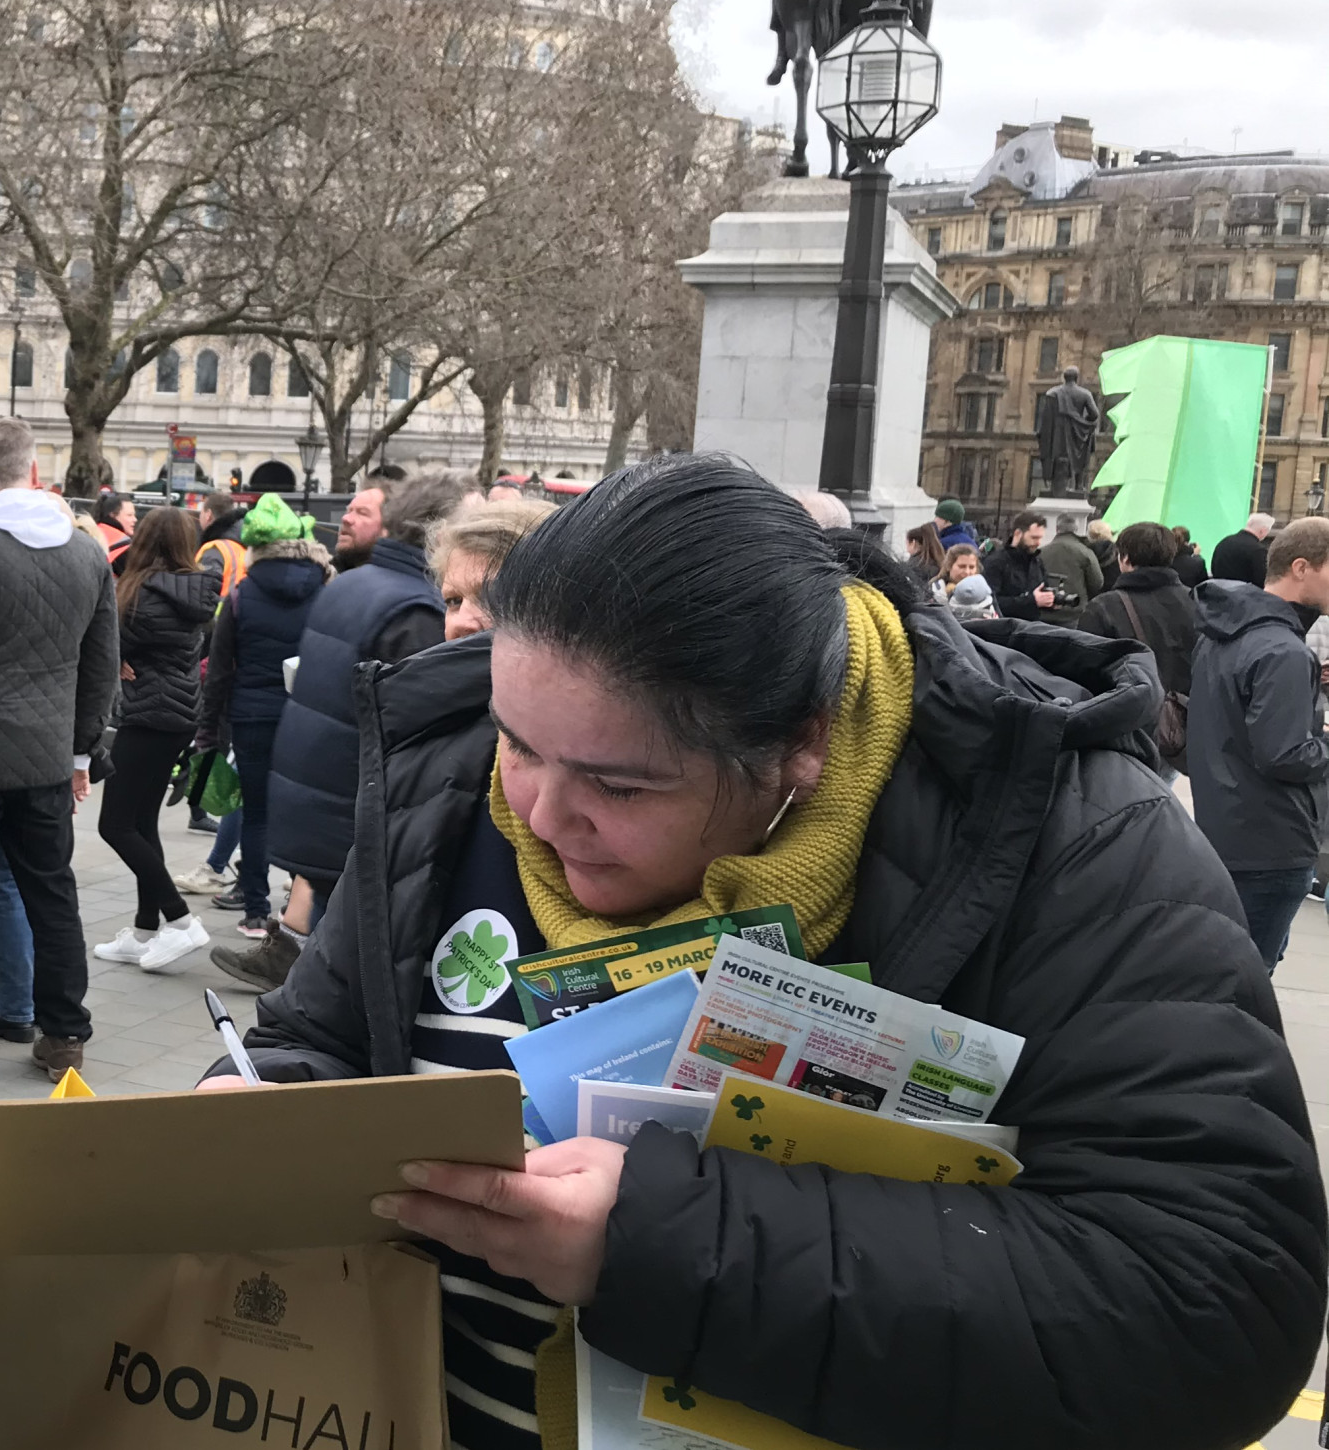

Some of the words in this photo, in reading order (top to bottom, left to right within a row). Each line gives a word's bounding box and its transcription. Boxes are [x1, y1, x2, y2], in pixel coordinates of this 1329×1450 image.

[463, 937, 491, 963] HAPPY
[488, 960, 500, 972] ST
[613, 969, 633, 982] 16
[645, 960, 665, 974] 19
[667, 944, 722, 969] MARC
[444, 941, 482, 978] PATRICK'S
[479, 974, 500, 996] DAY!
[562, 967, 582, 977] Irish
[564, 972, 600, 985] Cultural
[567, 982, 598, 993] Centre
[721, 960, 775, 988] MORE
[776, 979, 807, 999] ICC
[808, 991, 878, 1024] EVENTS
[747, 1007, 804, 1034] PHOTOGRAPHY
[568, 1069, 586, 1082] This
[587, 1065, 603, 1077] map
[603, 1060, 612, 1070] of
[612, 1050, 638, 1066] Ireland
[639, 1037, 674, 1056] contains:
[706, 1037, 765, 1064] EXHIBITION
[828, 1043, 859, 1058] LONDON
[866, 1057, 897, 1072] IRELAND
[963, 1053, 991, 1068] Centre
[966, 1045, 998, 1061] Cultural
[912, 1072, 951, 1091] CLASSES
[916, 1063, 941, 1076] IRISH
[942, 1072, 992, 1094] LANGUAGE
[782, 1138, 797, 1160] and
